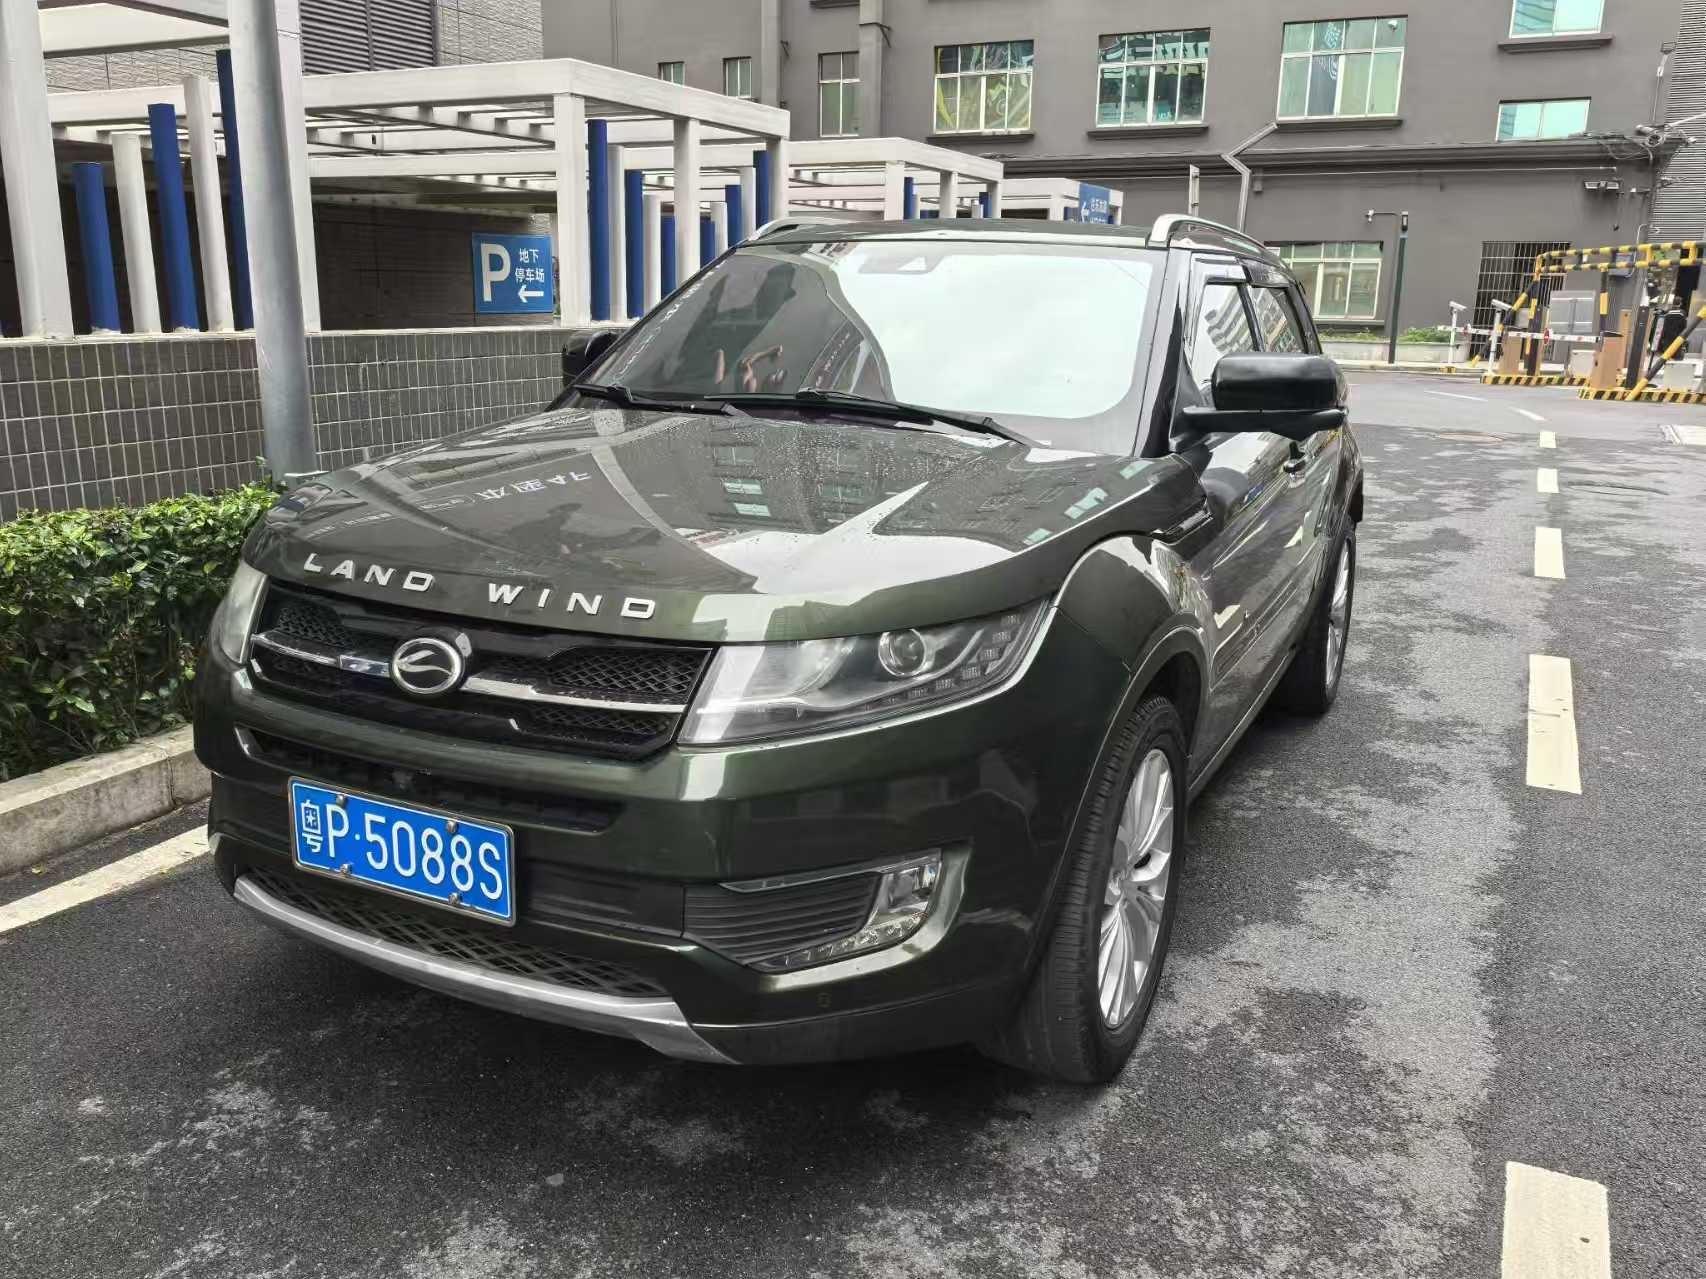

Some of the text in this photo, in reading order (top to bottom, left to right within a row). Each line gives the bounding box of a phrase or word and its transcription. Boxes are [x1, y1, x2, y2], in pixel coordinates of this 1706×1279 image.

[481, 243, 511, 302] P
[519, 247, 540, 263] 地下
[515, 267, 545, 283] 停车场
[303, 552, 656, 619] LAND WIND
